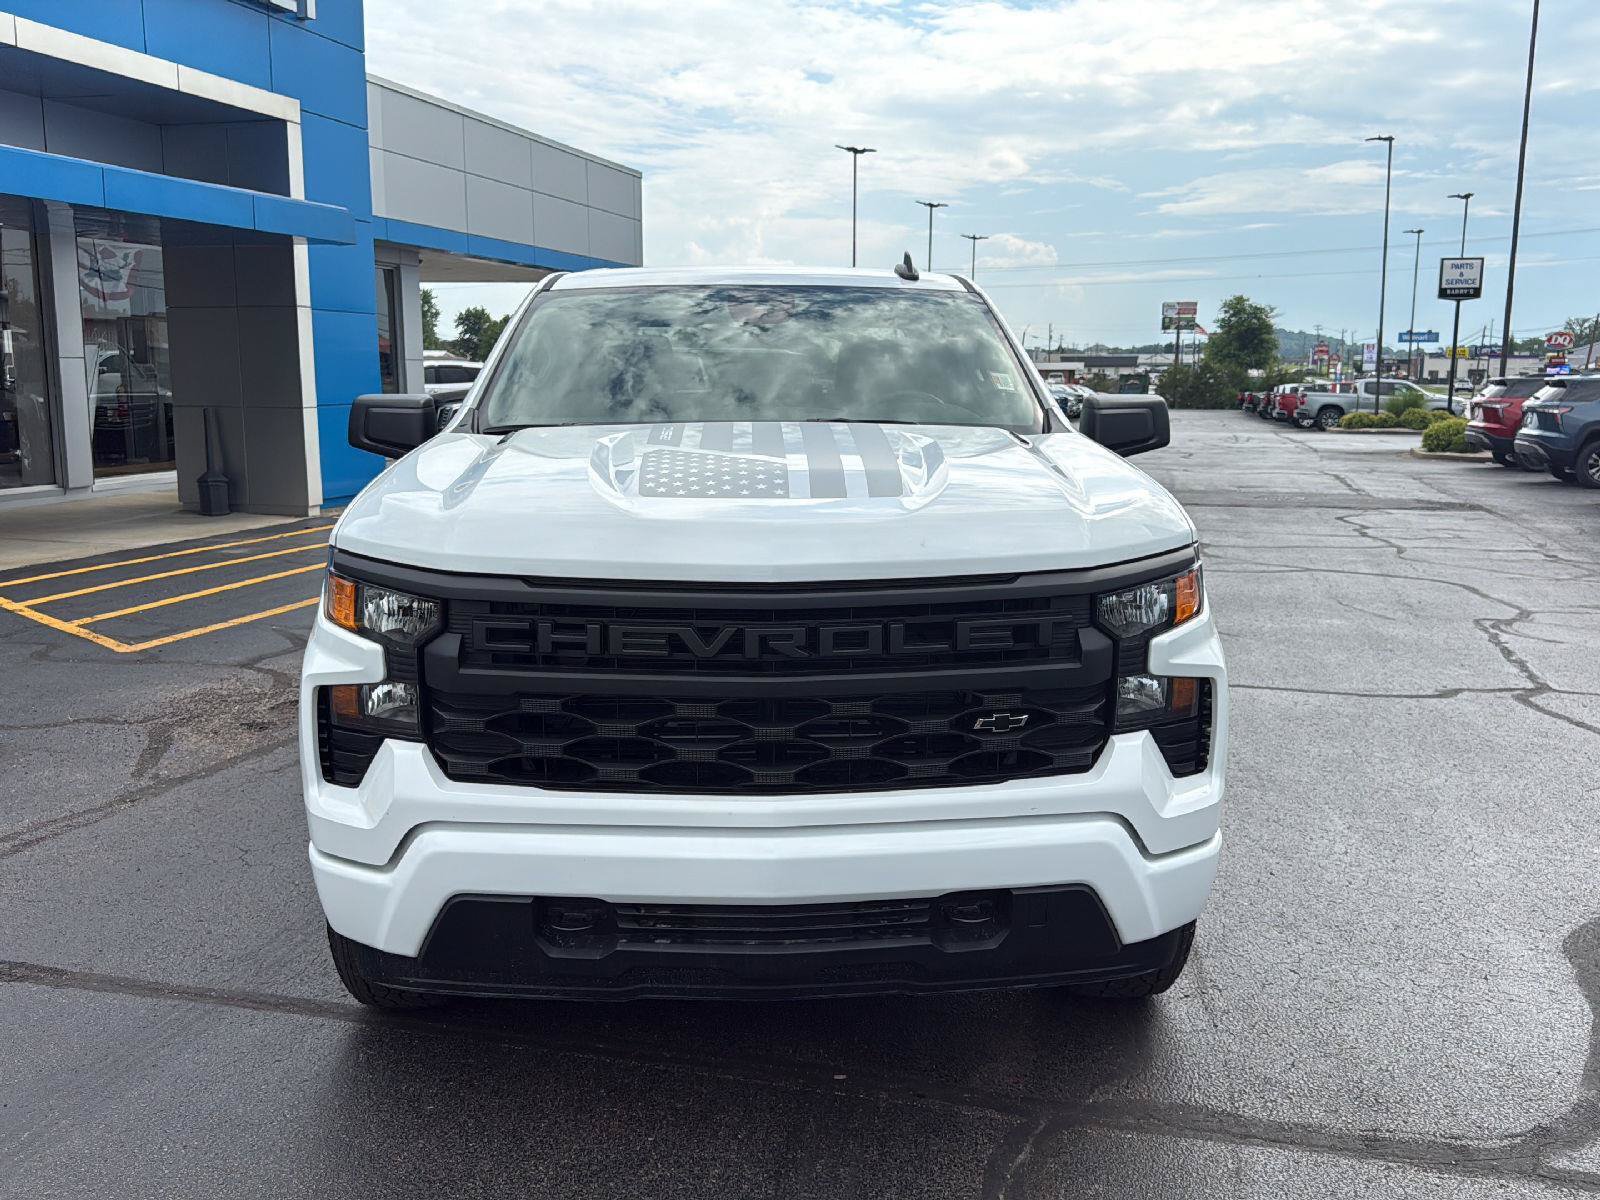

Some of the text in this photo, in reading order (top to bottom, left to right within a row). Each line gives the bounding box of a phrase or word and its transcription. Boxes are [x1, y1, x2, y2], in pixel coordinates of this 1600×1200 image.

[1445, 278, 1478, 286] SERVICE
[1551, 335, 1570, 346] DQ
[472, 614, 1073, 659] CHEVROLET
